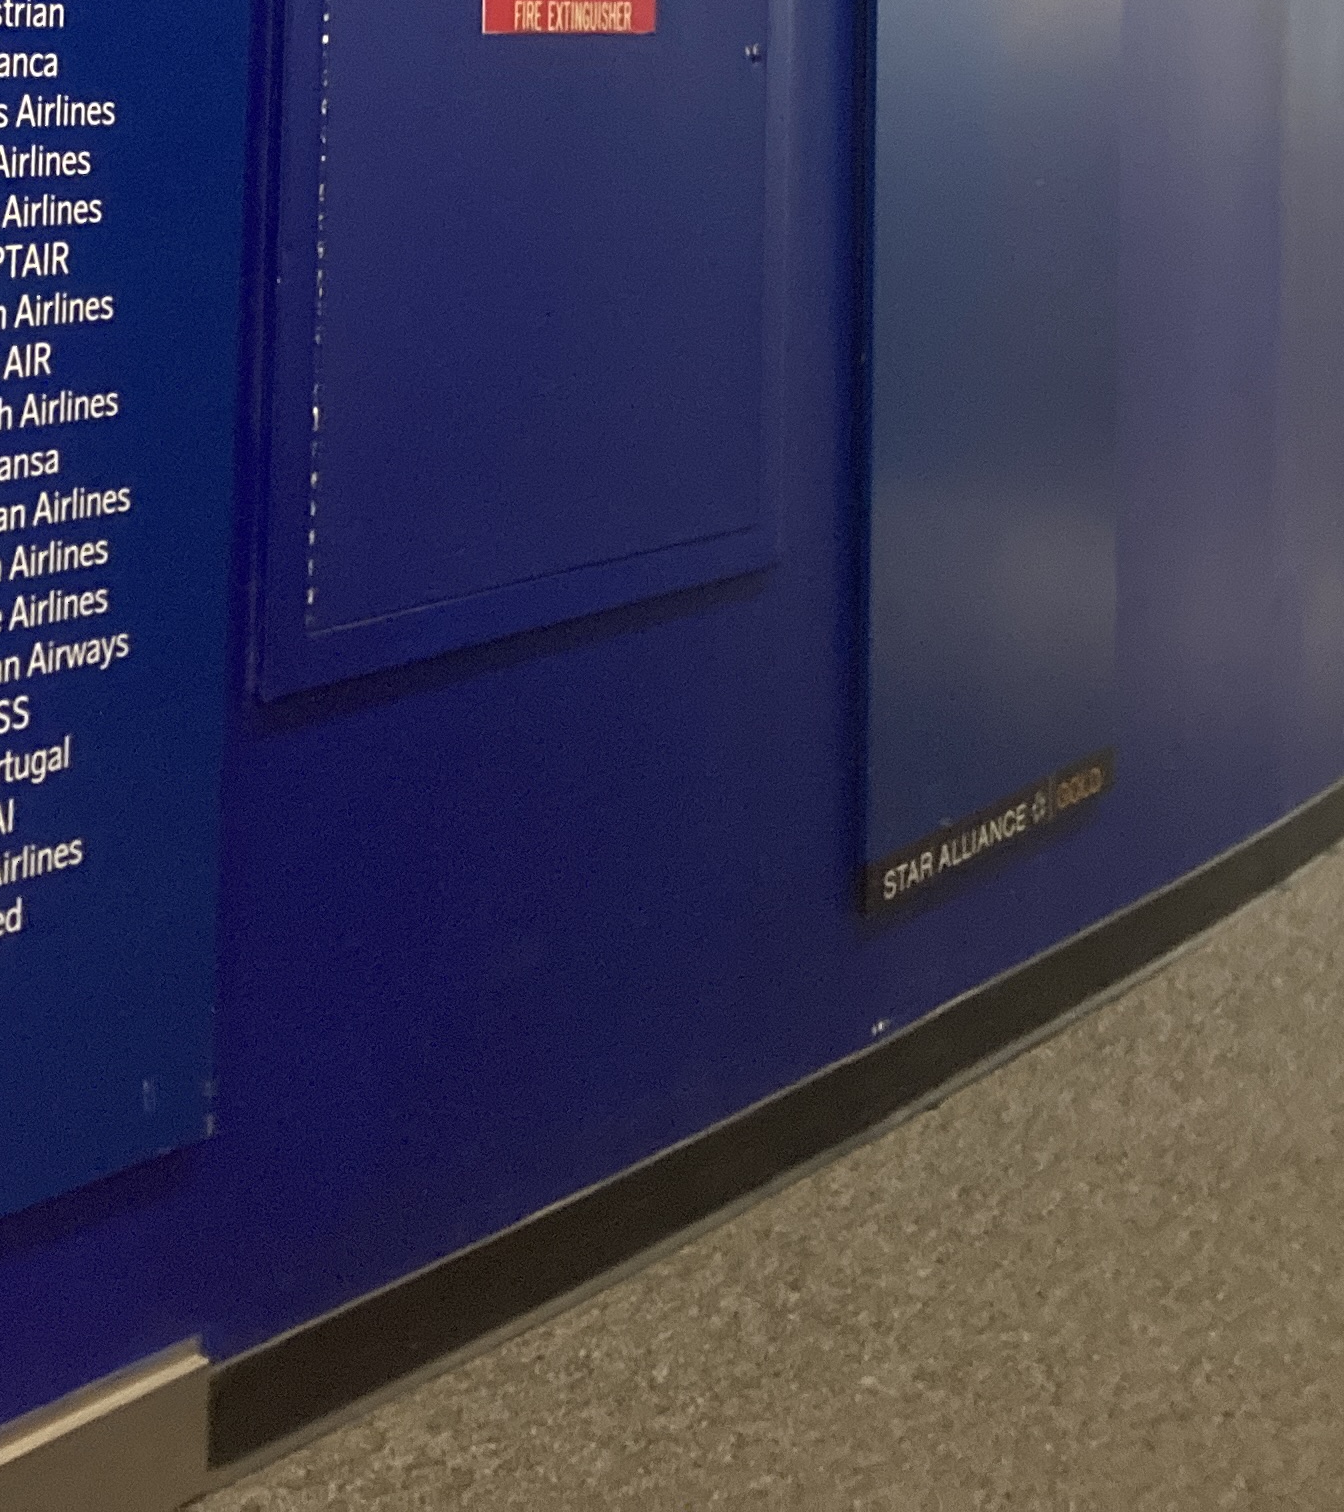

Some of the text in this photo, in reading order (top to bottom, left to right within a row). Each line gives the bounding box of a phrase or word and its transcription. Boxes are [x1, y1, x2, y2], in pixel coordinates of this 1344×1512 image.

[515, 0, 632, 31] FIRE EXTINGUISHER
[16, 94, 115, 127] Airlines
[2, 195, 102, 228] Airlines
[15, 293, 114, 327] Airlines
[4, 343, 51, 380] AIR
[20, 391, 119, 428] Airlines
[33, 486, 131, 526] Airlines
[9, 537, 109, 581] Airlines
[9, 586, 109, 630] Airlines
[27, 630, 130, 678] Airways
[883, 851, 933, 900] STAR
[938, 803, 1026, 873] ALLIANCE
